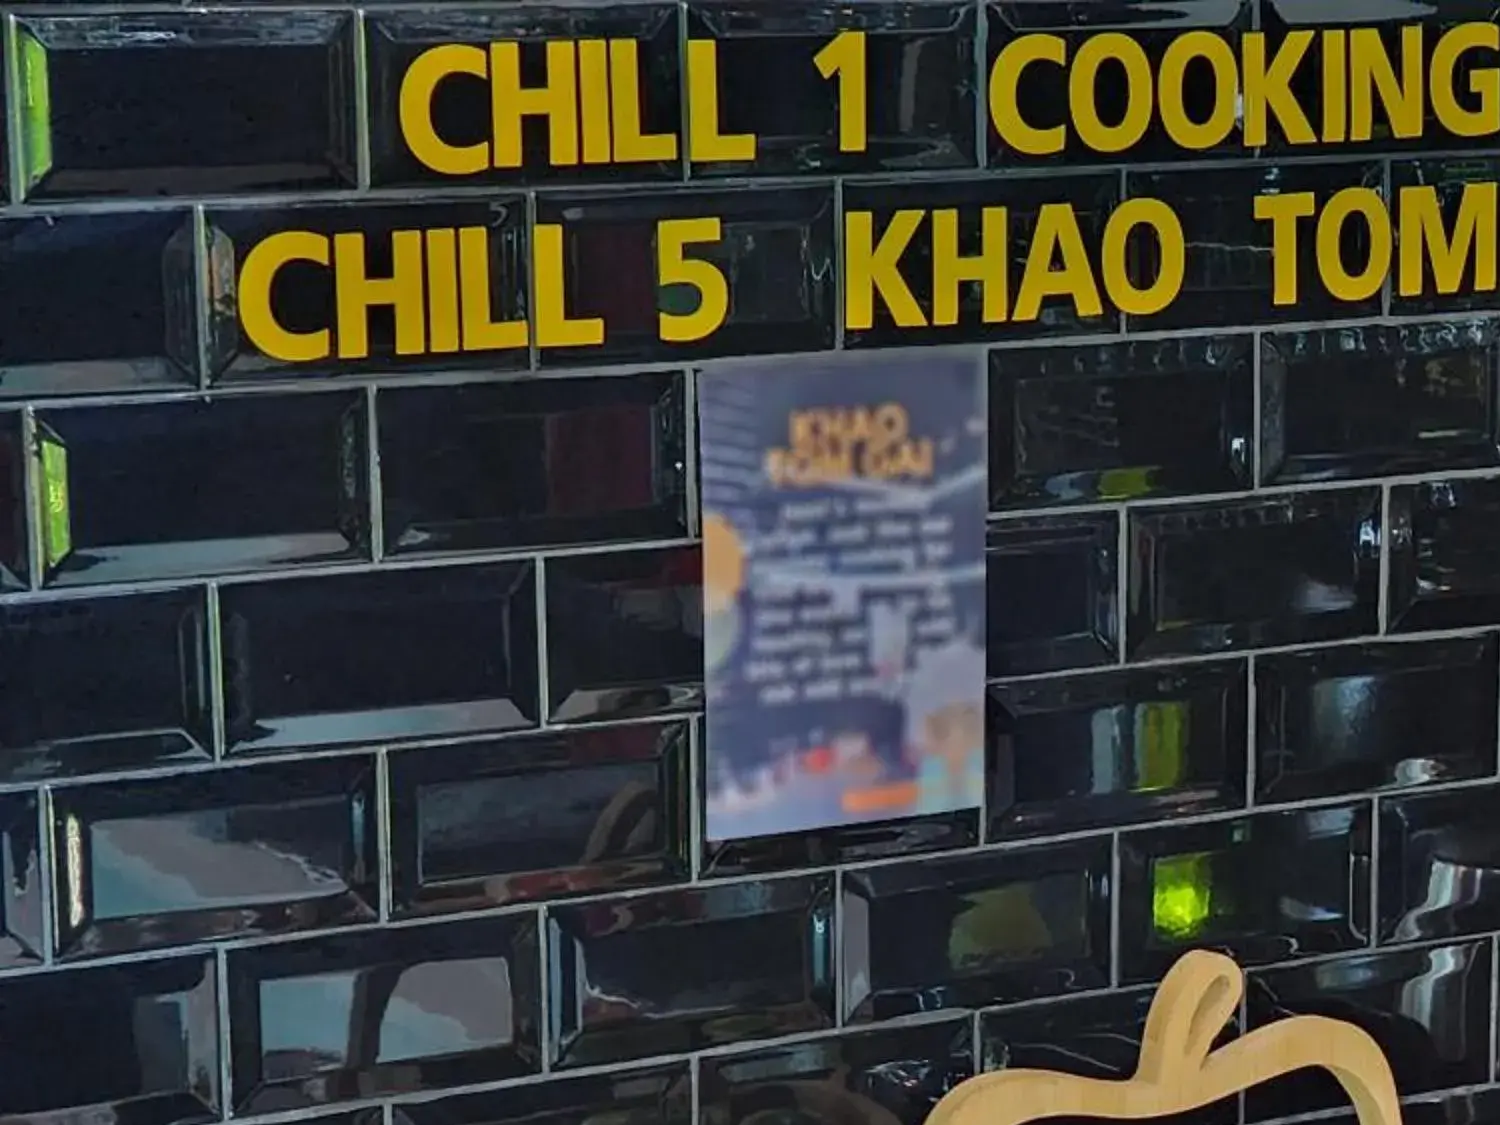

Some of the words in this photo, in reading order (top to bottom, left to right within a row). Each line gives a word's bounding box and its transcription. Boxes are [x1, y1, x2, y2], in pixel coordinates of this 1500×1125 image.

[399, 38, 756, 175] CHILL
[813, 31, 867, 152] 1
[237, 224, 605, 362] CHILL
[657, 218, 729, 342] 5
[845, 198, 1185, 330] KHAO
[1253, 182, 1497, 303] TOM
